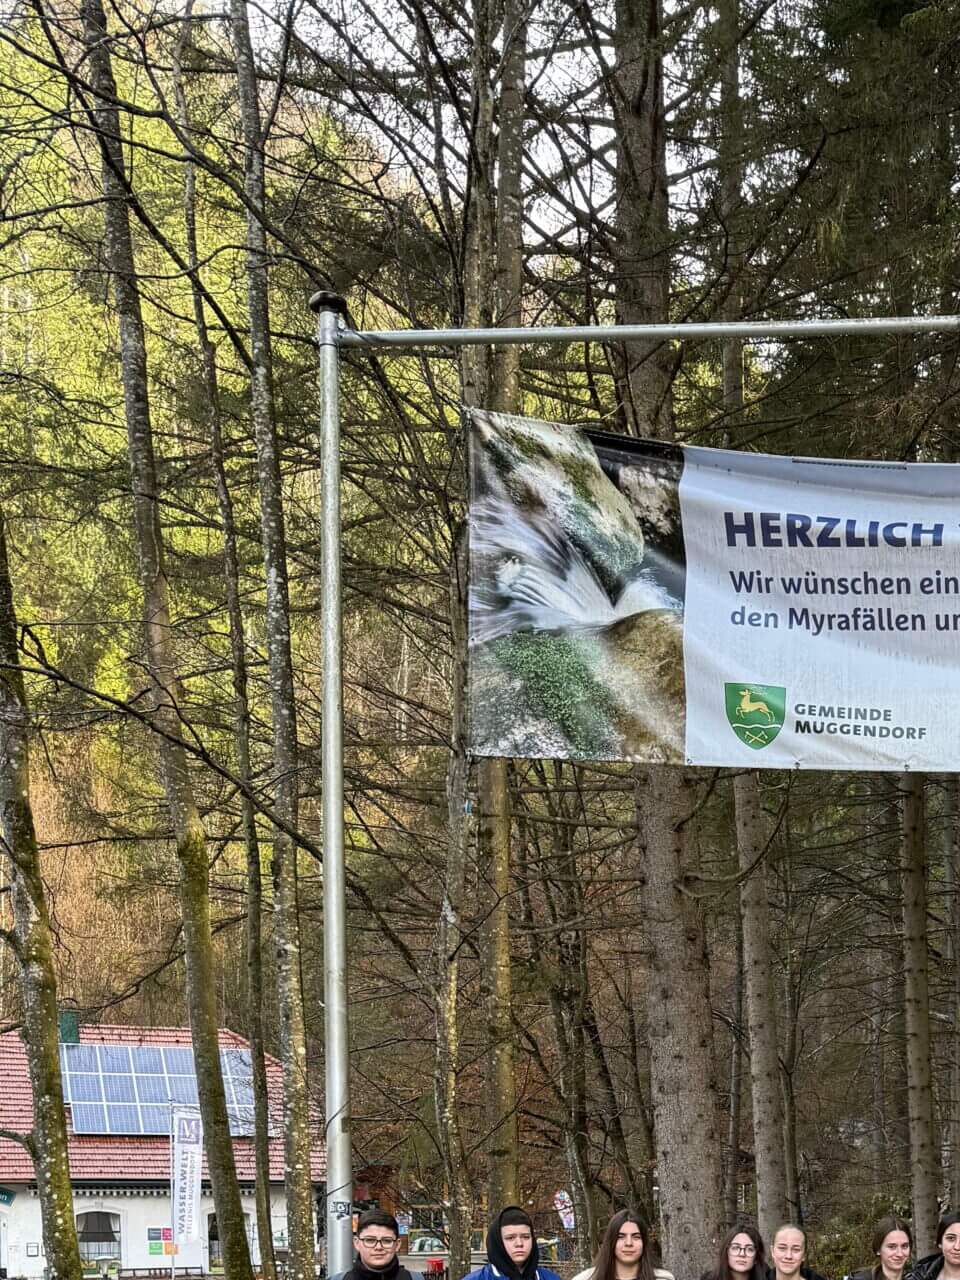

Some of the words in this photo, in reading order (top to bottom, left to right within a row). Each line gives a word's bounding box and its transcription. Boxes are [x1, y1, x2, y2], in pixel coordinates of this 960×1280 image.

[724, 511, 944, 548] HERZLICH
[729, 570, 773, 594] Wir
[781, 570, 911, 595] wünschen
[730, 605, 779, 629] den
[788, 606, 926, 636] Myrafällen
[794, 703, 892, 722] GEMEINDE
[794, 720, 927, 740] MUGGENDORF
[178, 1149, 189, 1235] WASSER.WELT
